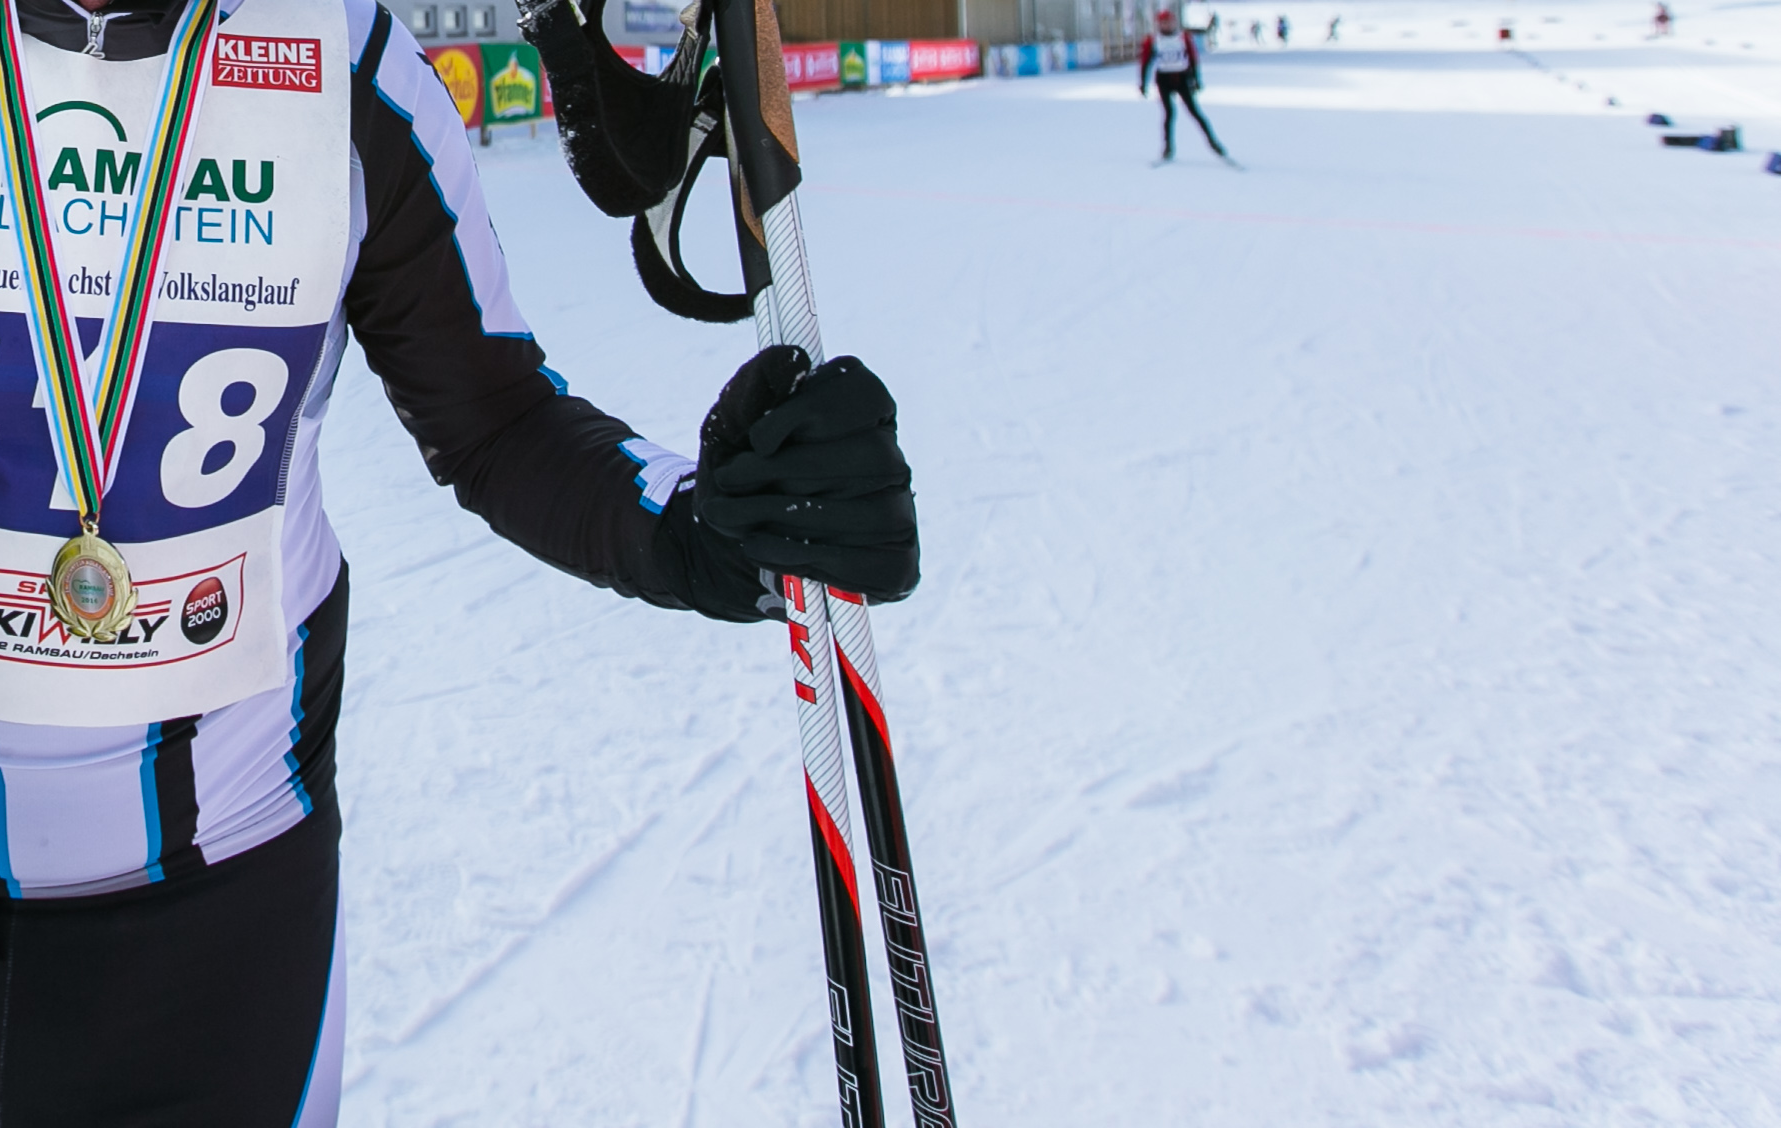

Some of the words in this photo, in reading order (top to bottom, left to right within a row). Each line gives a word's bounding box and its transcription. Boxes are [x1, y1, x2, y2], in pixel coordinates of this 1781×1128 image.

[218, 38, 316, 65] KLEINE
[217, 65, 318, 88] ZEITUNG
[48, 147, 274, 203] AMAU
[185, 591, 223, 616] SPORT
[187, 607, 222, 628] 2000
[12, 644, 159, 660] RAMSAU/Dachstein
